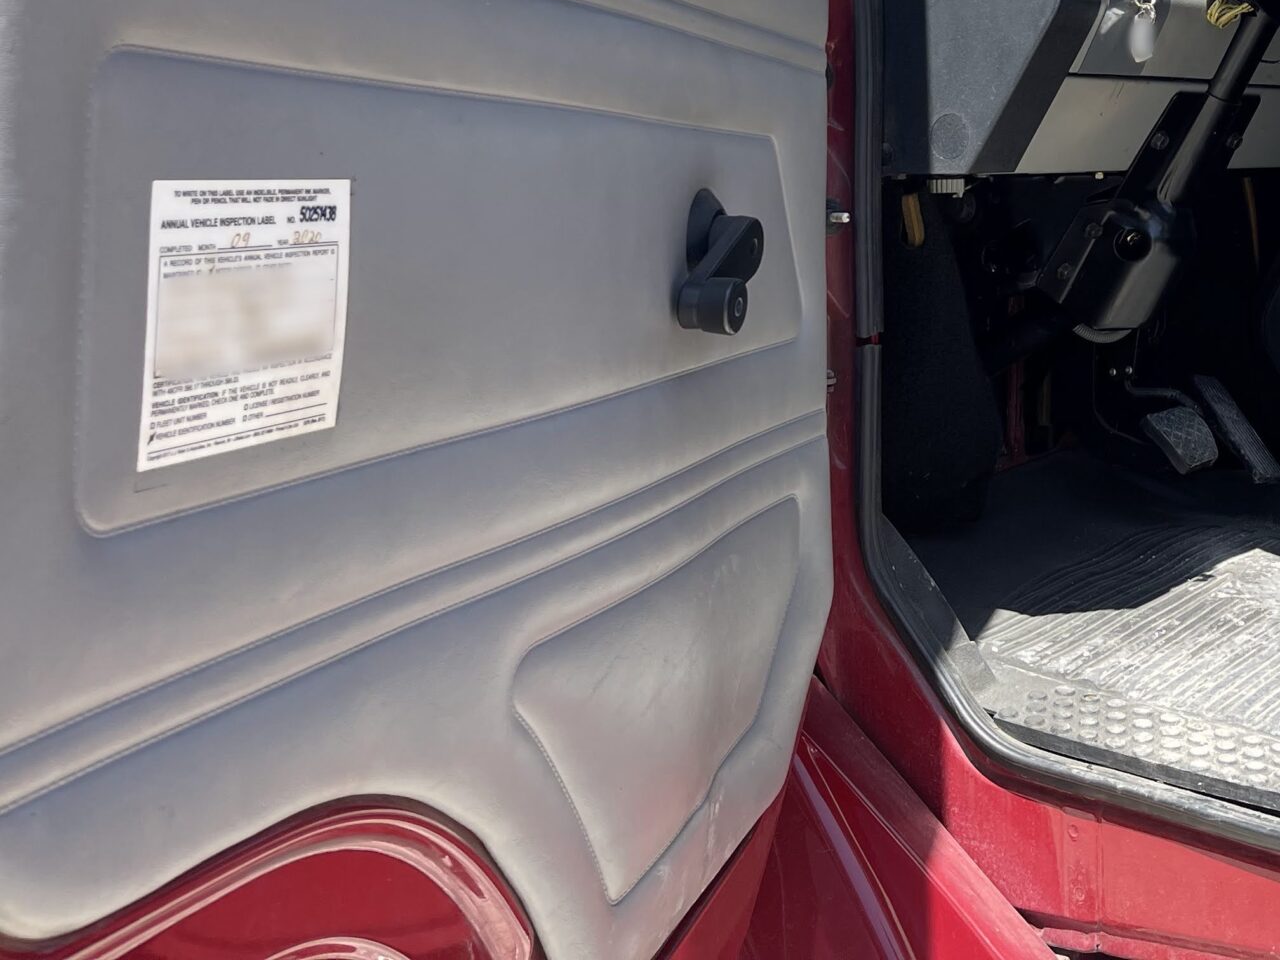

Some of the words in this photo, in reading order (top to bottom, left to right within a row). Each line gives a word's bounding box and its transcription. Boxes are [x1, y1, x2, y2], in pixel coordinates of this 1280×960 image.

[160, 219, 189, 230] ANNUAL
[191, 218, 218, 228] VEHICLE
[219, 217, 256, 227] INSPECTION
[257, 216, 276, 225] LABEL
